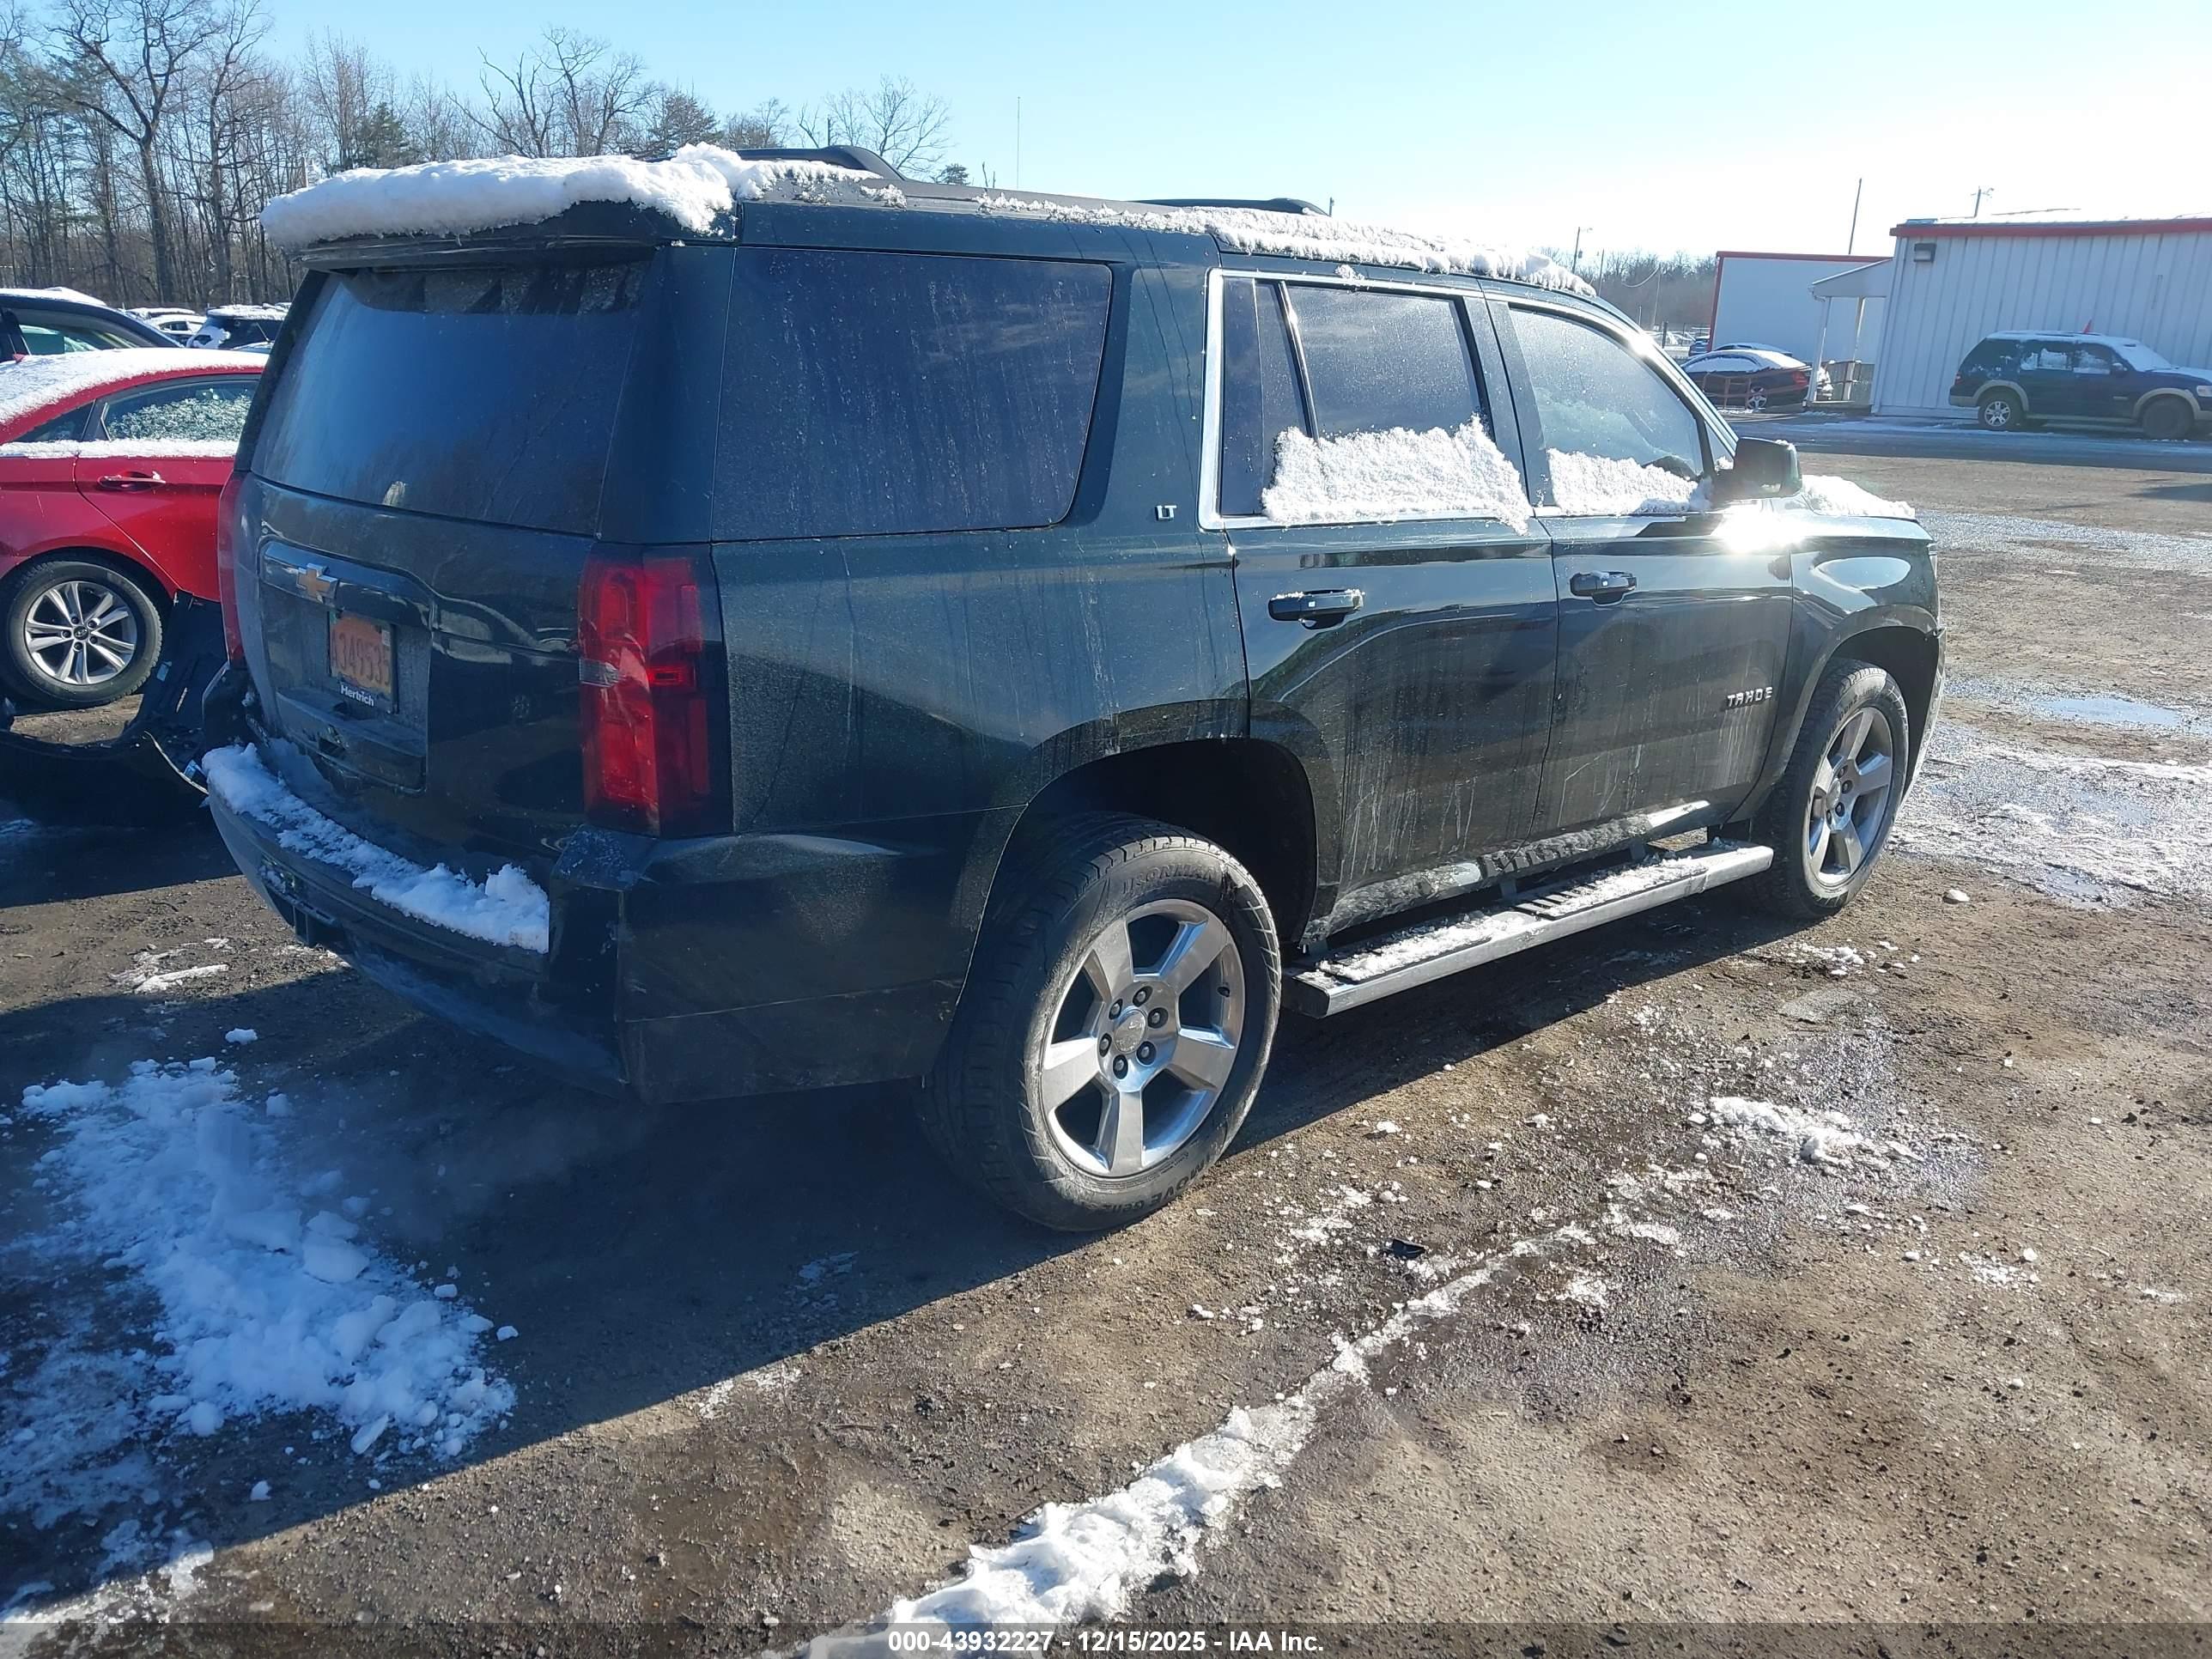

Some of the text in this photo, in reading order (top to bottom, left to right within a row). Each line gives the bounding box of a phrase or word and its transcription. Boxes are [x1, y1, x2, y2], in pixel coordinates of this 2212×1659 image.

[1157, 505, 1177, 520] LT
[340, 684, 374, 708] Hertrich
[1727, 686, 1773, 708] TAHOE
